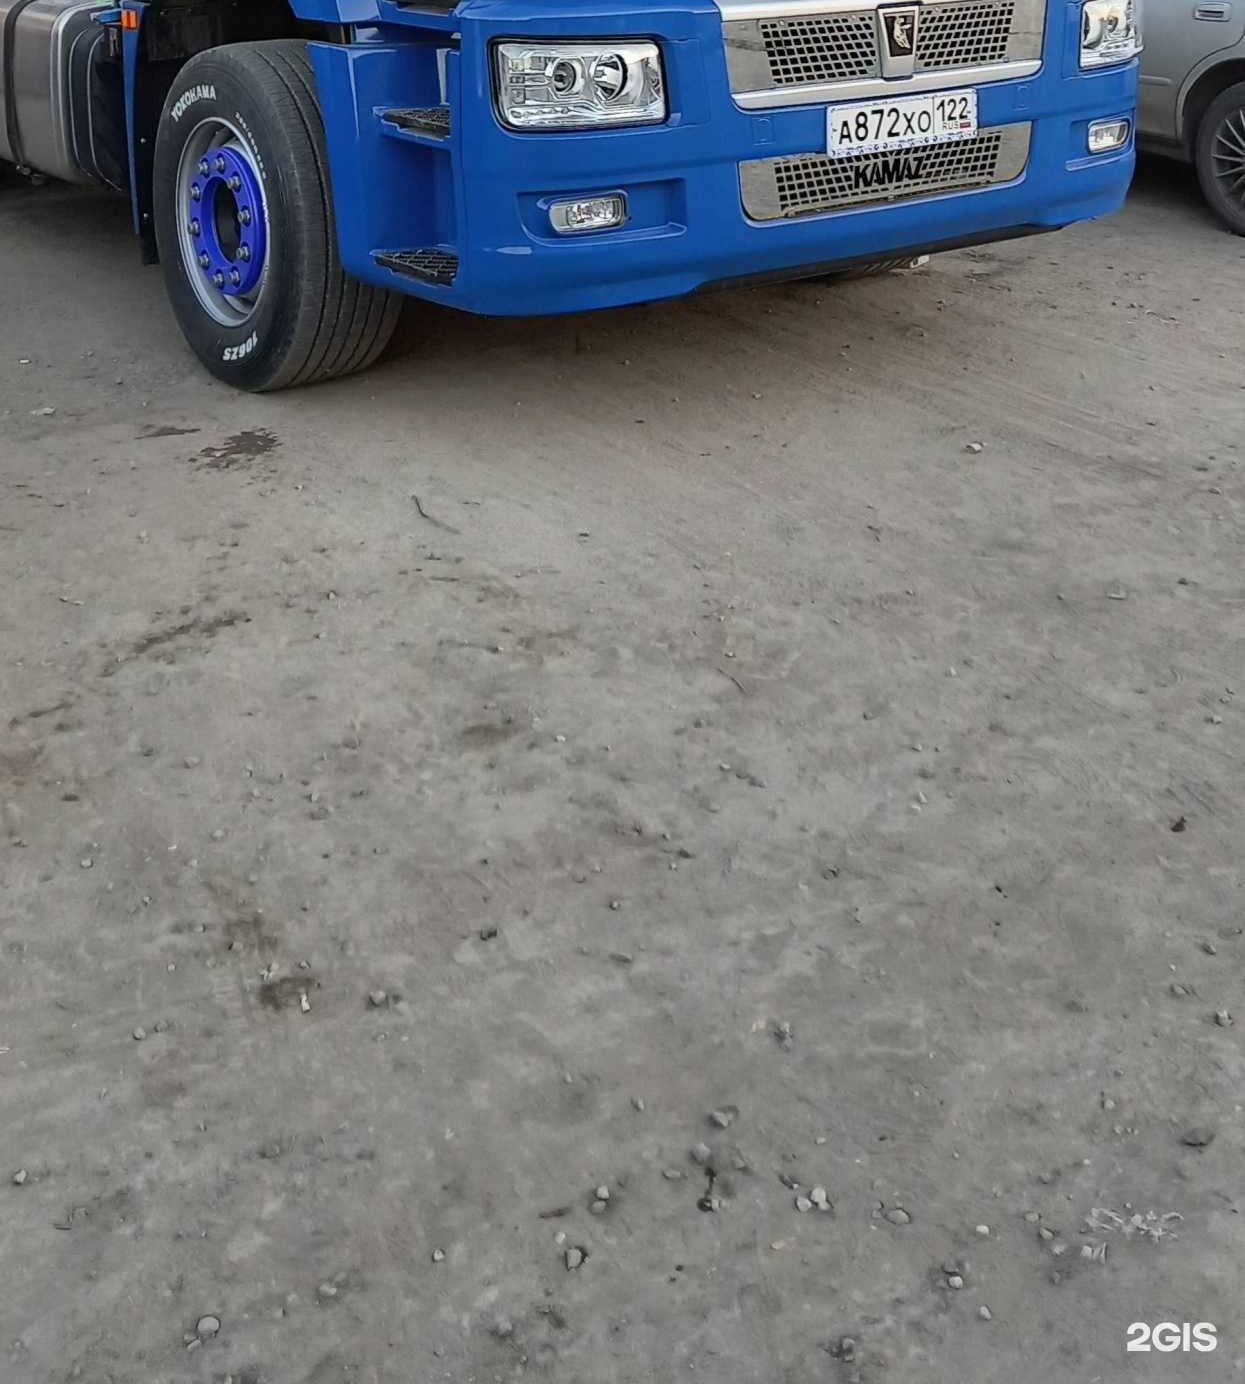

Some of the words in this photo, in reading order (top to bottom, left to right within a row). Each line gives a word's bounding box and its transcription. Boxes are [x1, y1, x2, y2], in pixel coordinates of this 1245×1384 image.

[171, 84, 217, 122] YOKOHAMA
[936, 96, 969, 123] 122
[943, 120, 960, 131] RUS
[852, 155, 925, 189] KAMAZ
[222, 330, 258, 361] 106ZS
